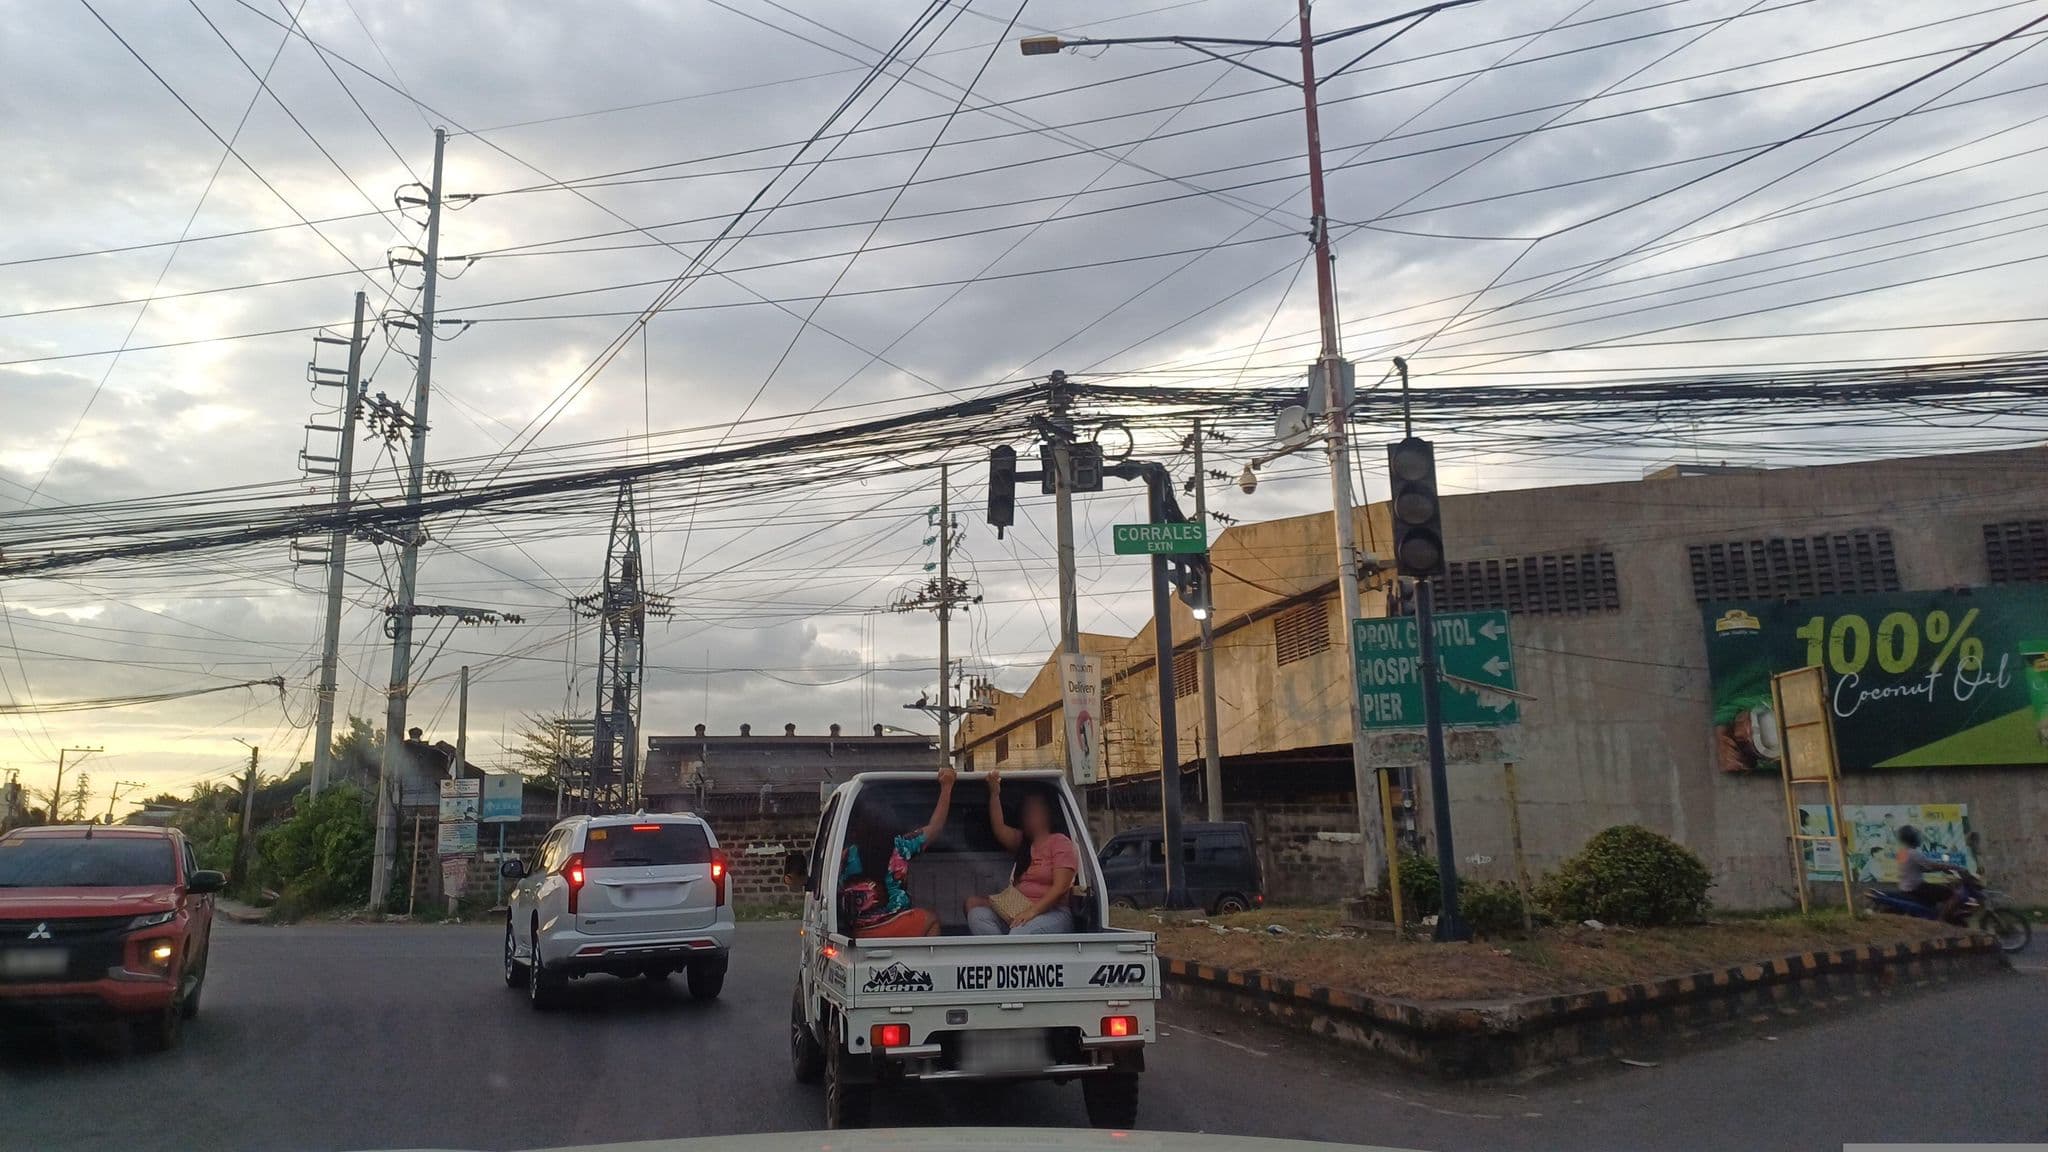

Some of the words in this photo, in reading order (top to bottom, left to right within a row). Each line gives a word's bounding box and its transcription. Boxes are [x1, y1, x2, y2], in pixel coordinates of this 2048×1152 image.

[1118, 526, 1202, 541] CORRALES
[1148, 541, 1174, 551] EXTN
[1357, 623, 1402, 651] PROV.
[1406, 618, 1476, 648] CPITOL
[1796, 607, 1984, 674] 100%
[1068, 680, 1096, 696] Delivery
[1833, 663, 1943, 718] Coconut
[1953, 653, 2011, 702] Oil
[1363, 692, 1403, 721] PIER
[957, 966, 992, 989] KEEP
[997, 964, 1064, 988] DISTANCE
[1088, 964, 1146, 986] 4WD
[863, 984, 933, 992] MIGHTY
